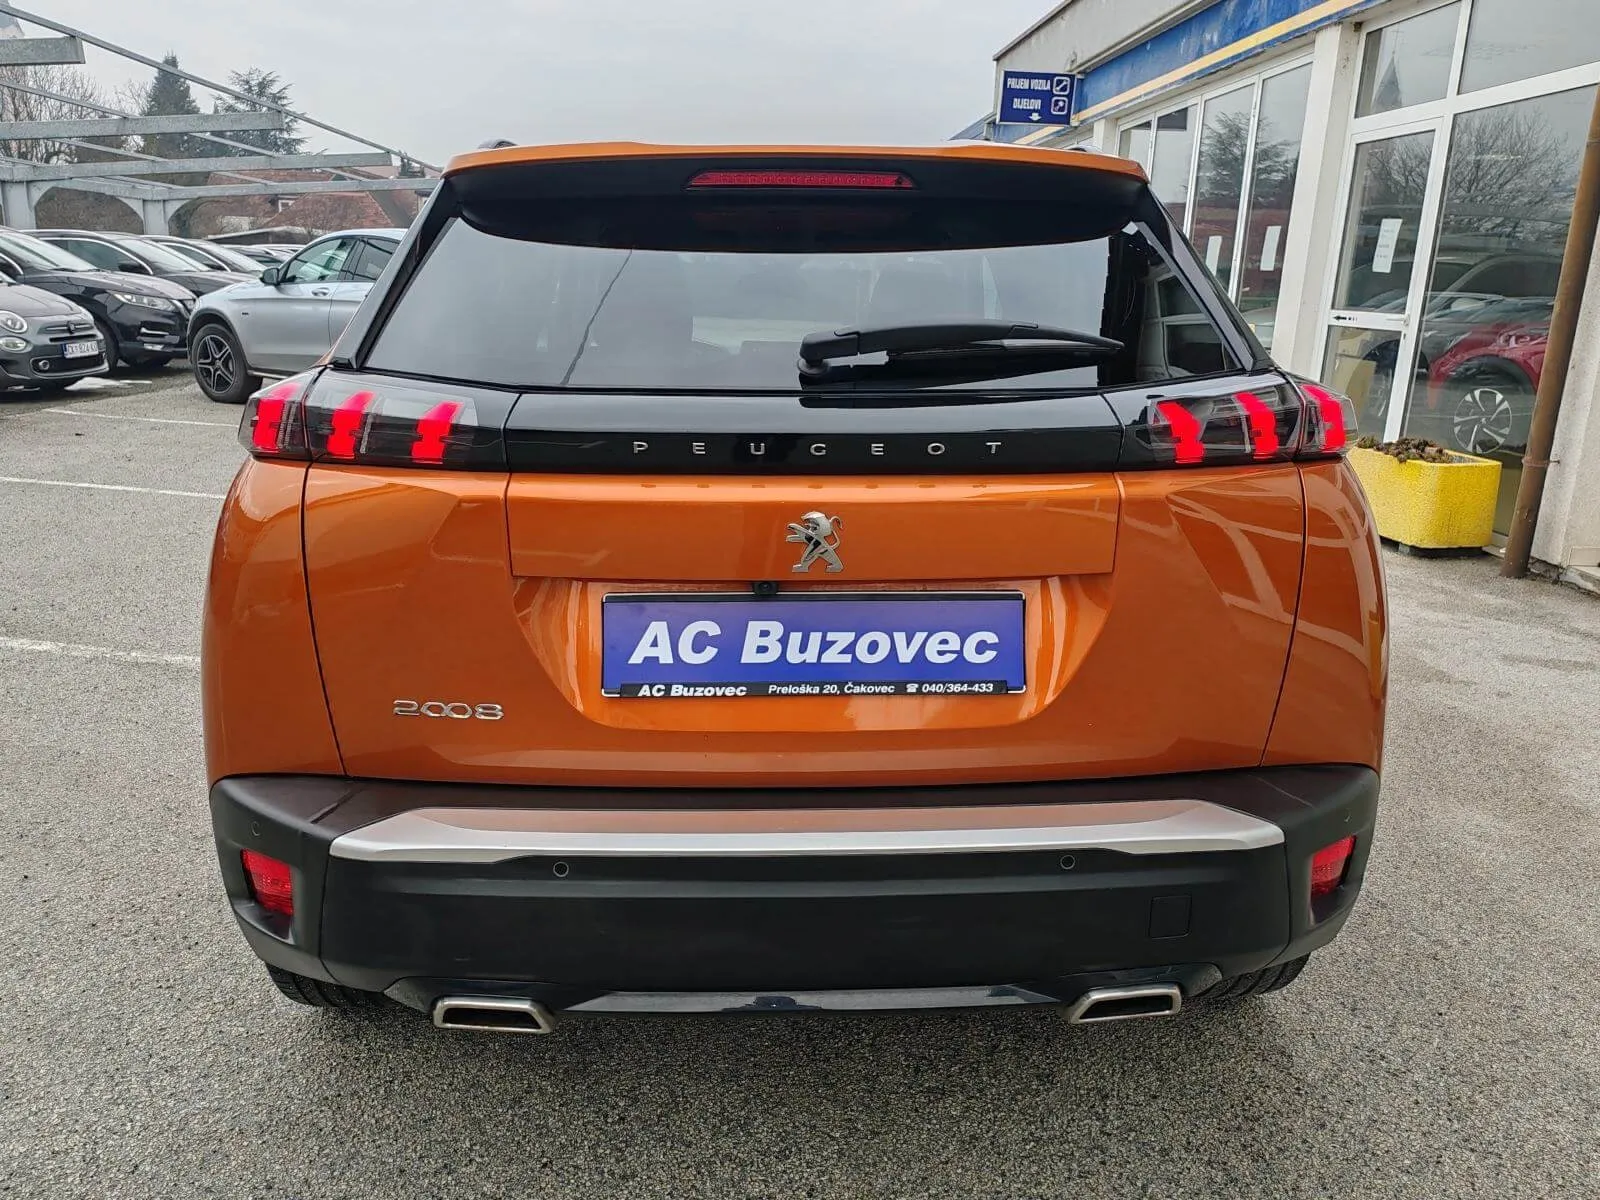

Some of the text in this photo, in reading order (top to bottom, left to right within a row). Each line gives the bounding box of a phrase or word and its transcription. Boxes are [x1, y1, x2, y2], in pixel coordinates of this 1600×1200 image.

[1007, 78, 1050, 90] PRIJEM VOZILA
[1013, 98, 1041, 110] DIJELOVI
[632, 441, 1002, 456] PEUGEOT
[628, 620, 1000, 664] AC Buzovec
[637, 681, 994, 697] AC Buzovec Preloška 20, Čakovec 040/364-433
[393, 699, 505, 720] 2008
